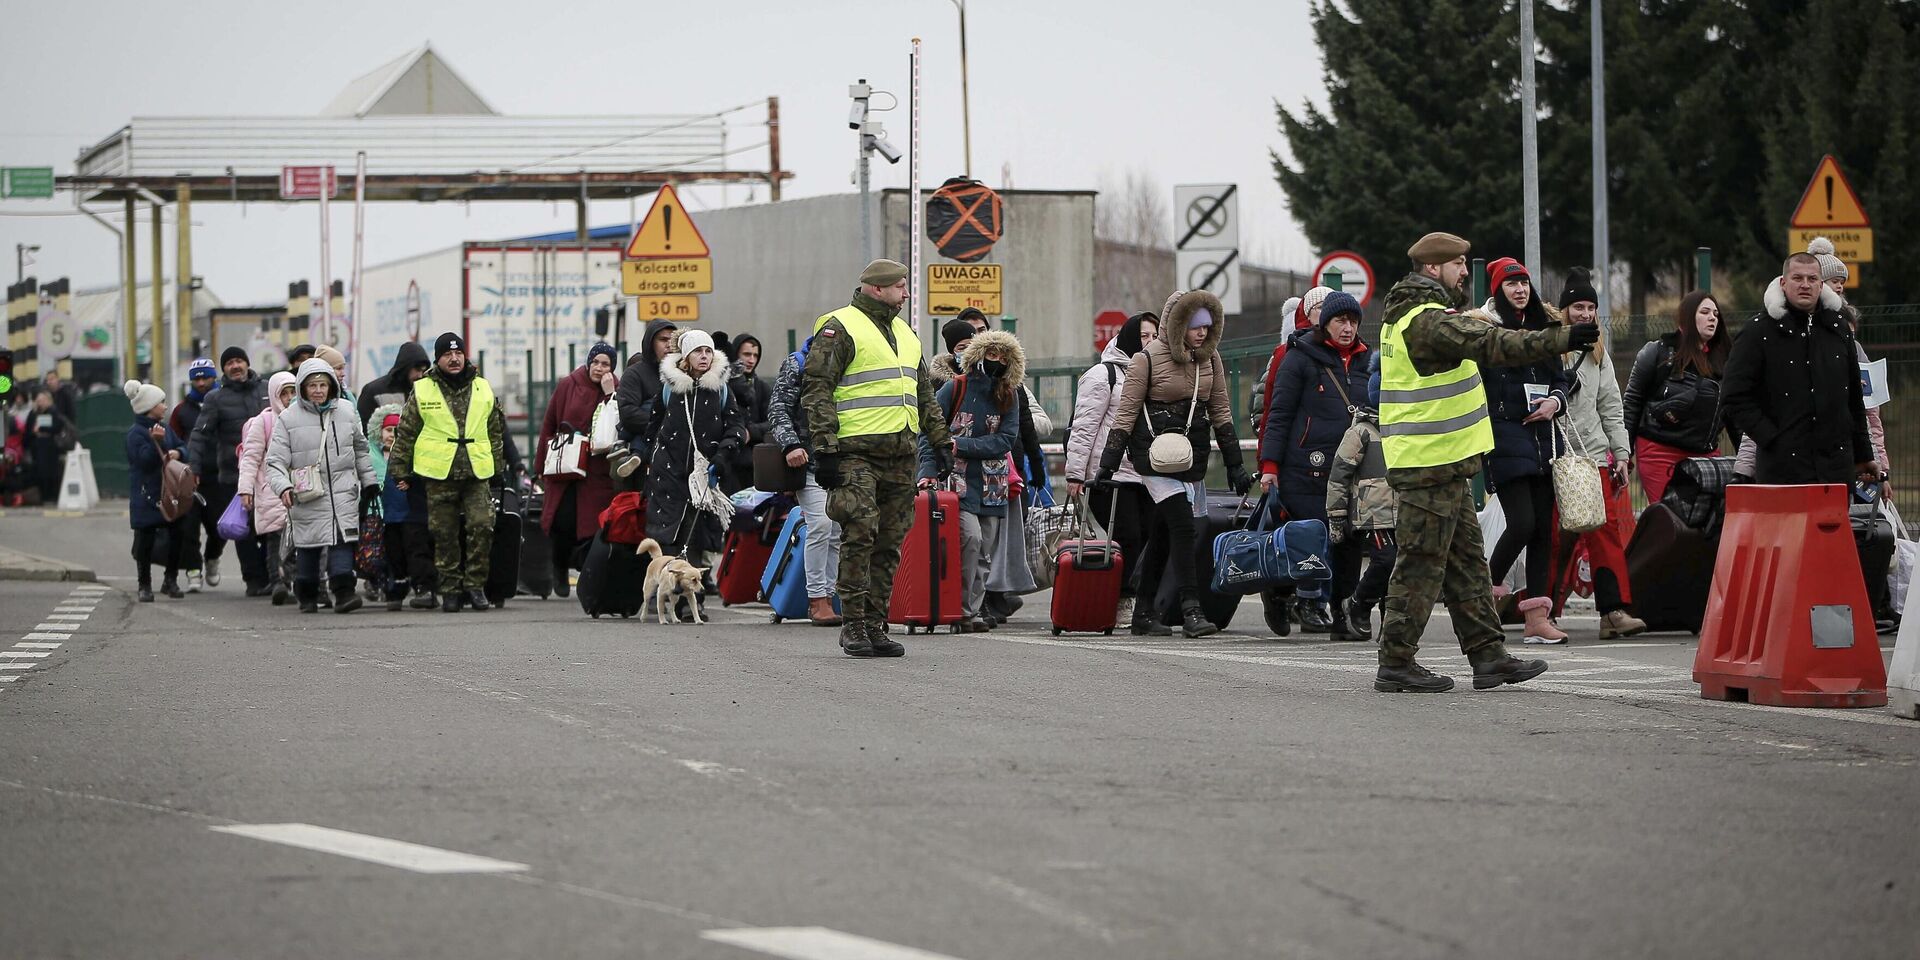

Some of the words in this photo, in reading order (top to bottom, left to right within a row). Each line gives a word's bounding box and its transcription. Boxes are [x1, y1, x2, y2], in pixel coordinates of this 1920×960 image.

[634, 262, 698, 274] Kolczatka
[932, 267, 996, 279] UWAGA!
[638, 280, 695, 293] drogowa
[483, 303, 525, 316] Alles
[650, 301, 671, 316] 30
[675, 304, 690, 315] m
[52, 324, 65, 345] 5
[330, 326, 340, 346] 5
[1095, 325, 1123, 341] STO
